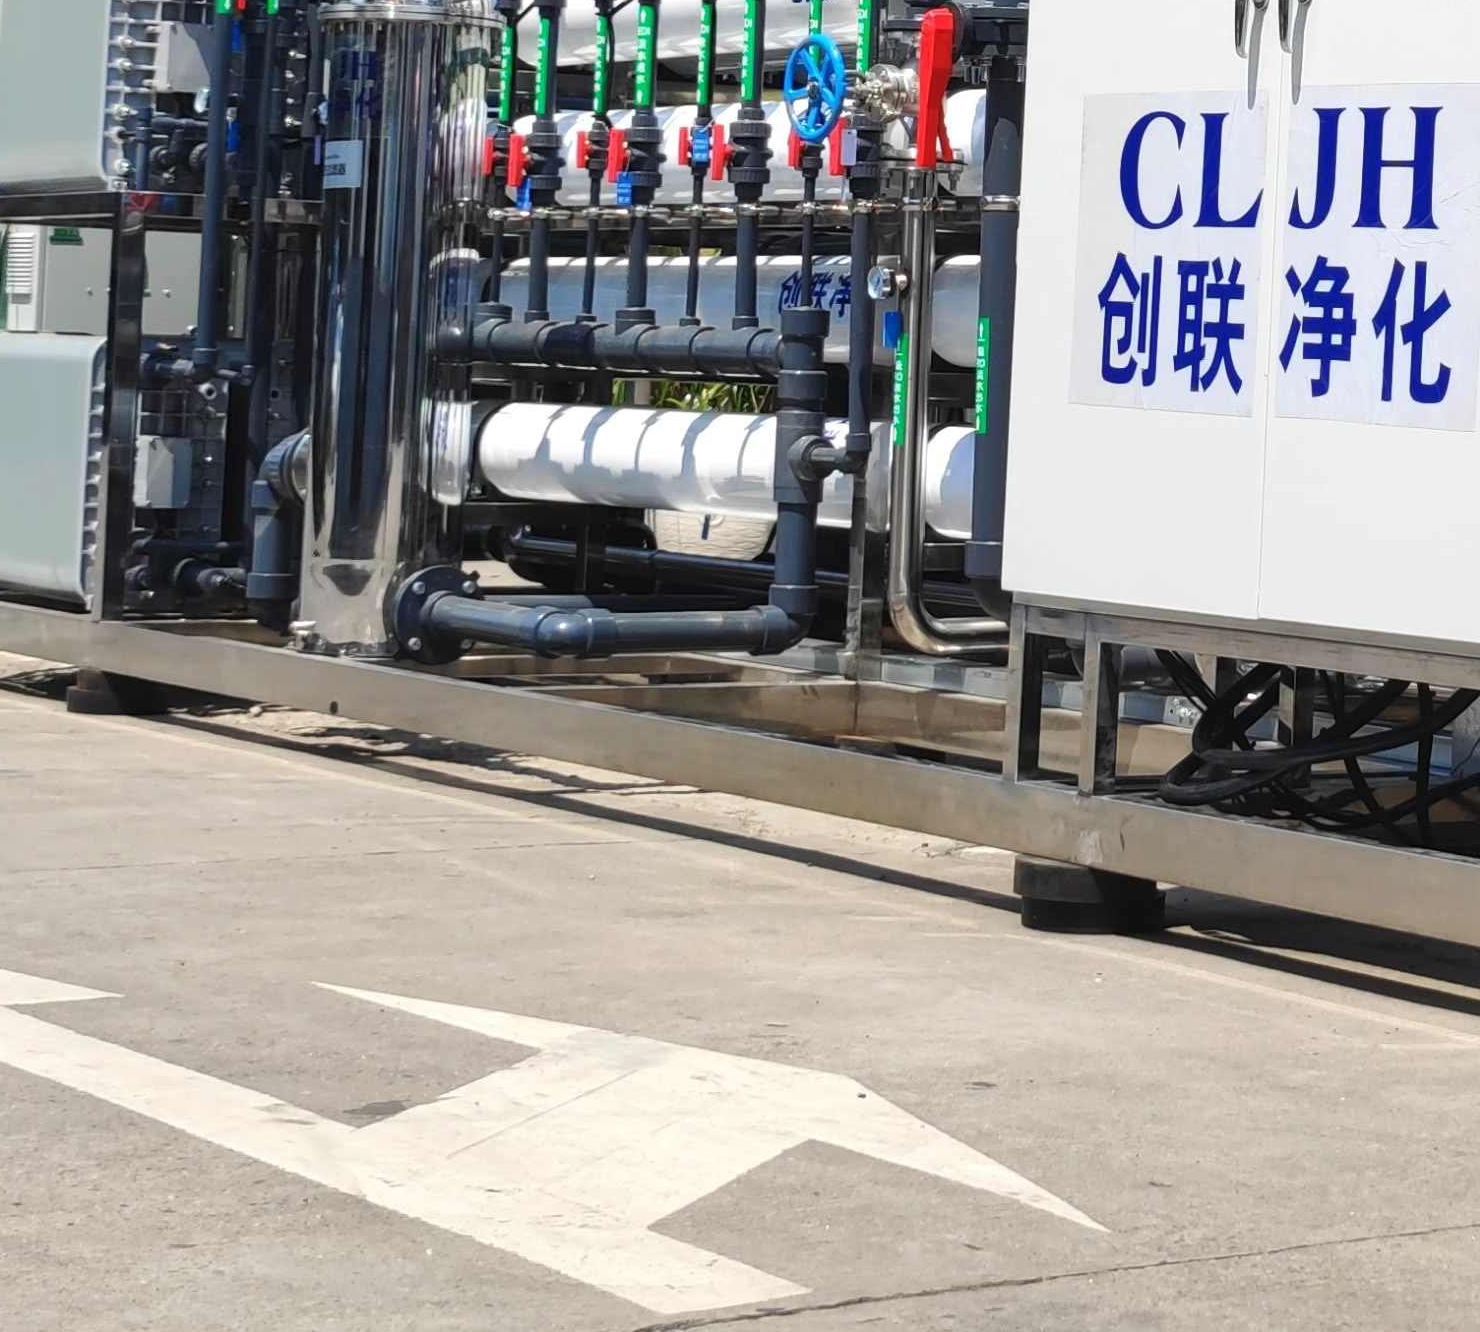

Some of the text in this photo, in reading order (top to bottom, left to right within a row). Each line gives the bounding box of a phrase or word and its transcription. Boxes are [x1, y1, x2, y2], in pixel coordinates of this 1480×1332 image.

[1120, 106, 1443, 230] CLJH
[1097, 253, 1452, 405] 创联净化
